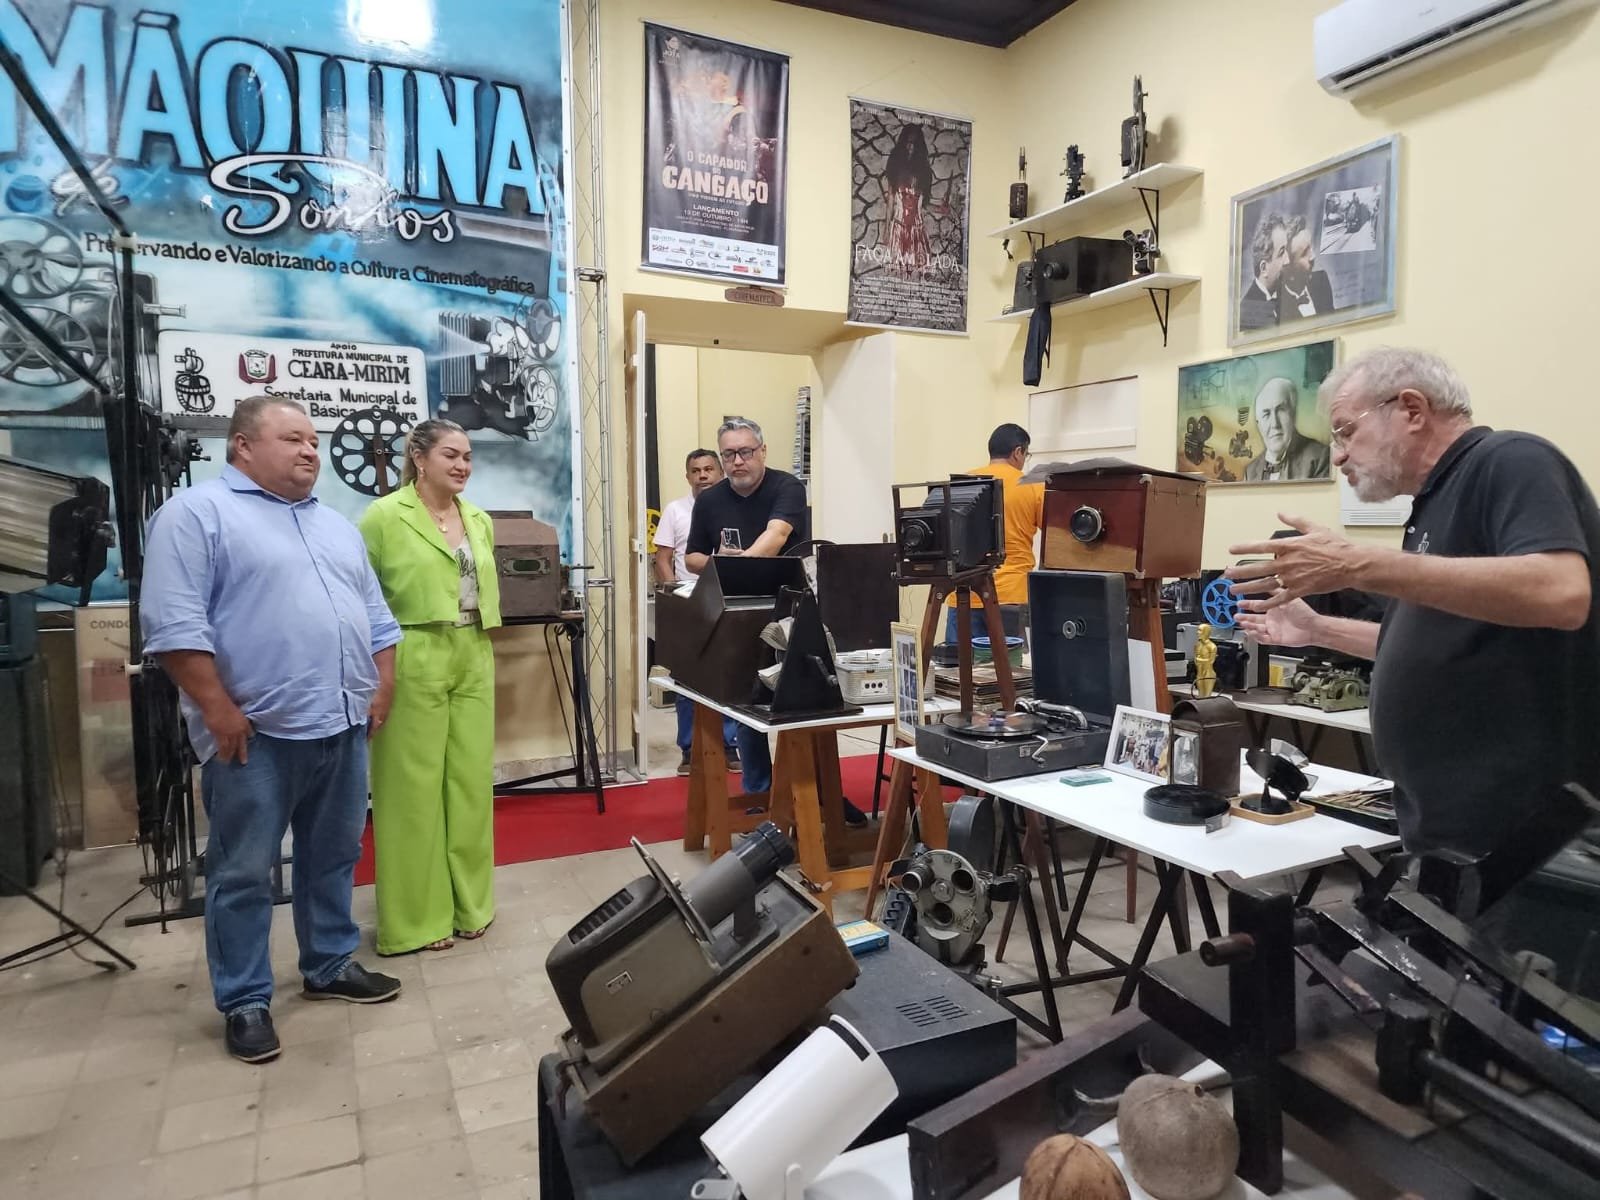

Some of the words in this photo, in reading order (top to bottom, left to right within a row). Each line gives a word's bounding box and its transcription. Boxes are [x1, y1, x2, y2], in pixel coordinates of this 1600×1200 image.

[661, 165, 769, 206] CANGAÇO
[85, 231, 211, 261] Prervando
[216, 247, 227, 263] e
[226, 245, 336, 273] Valorizando
[339, 261, 349, 274] a
[351, 259, 411, 282] Cultura
[412, 265, 536, 295] Cinematográfica
[292, 348, 344, 360] PREFEITURA
[346, 352, 393, 364] MUNICIPAL
[396, 355, 408, 364] DE
[340, 387, 400, 406] Municipal
[402, 390, 417, 405] de
